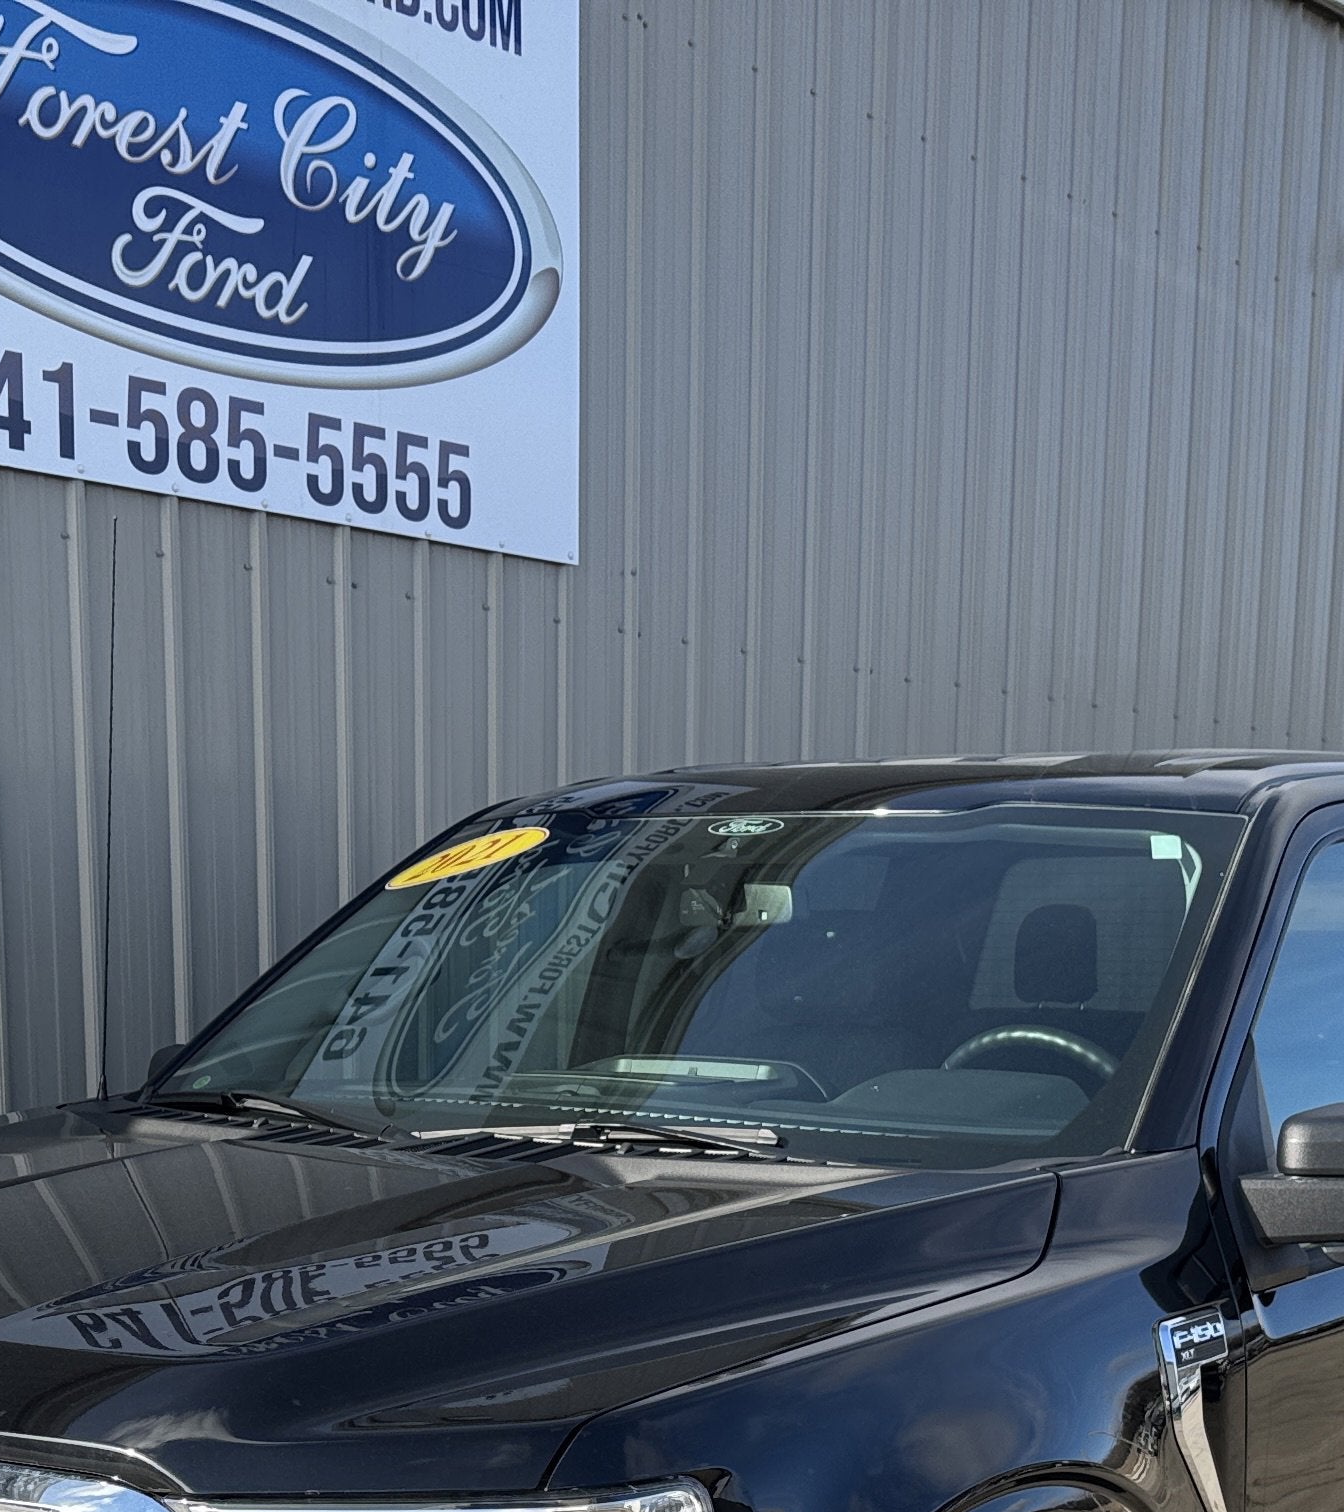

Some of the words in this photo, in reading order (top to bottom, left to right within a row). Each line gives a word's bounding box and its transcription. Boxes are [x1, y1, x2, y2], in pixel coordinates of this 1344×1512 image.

[111, 185, 312, 326] Ford
[273, 87, 459, 283] City
[1173, 1321, 1225, 1349] F-150
